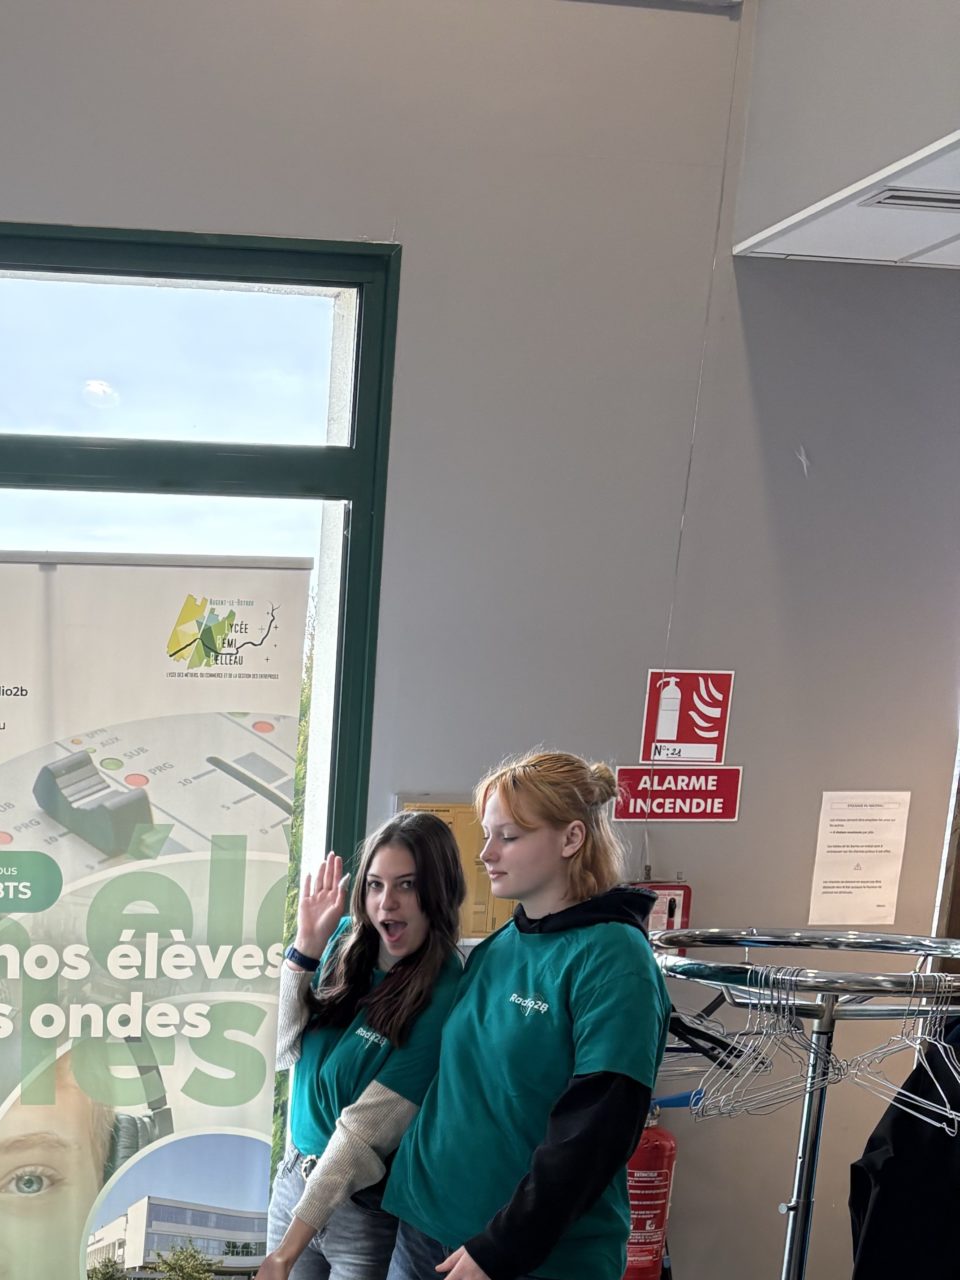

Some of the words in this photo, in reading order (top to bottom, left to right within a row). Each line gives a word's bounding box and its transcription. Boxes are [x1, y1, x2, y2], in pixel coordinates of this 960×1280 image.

[209, 652, 244, 666] BELLEAU
[149, 761, 176, 776] PRG
[638, 776, 718, 791] ALARME
[628, 798, 724, 814] INCENDIE
[30, 992, 211, 1038] ondes
